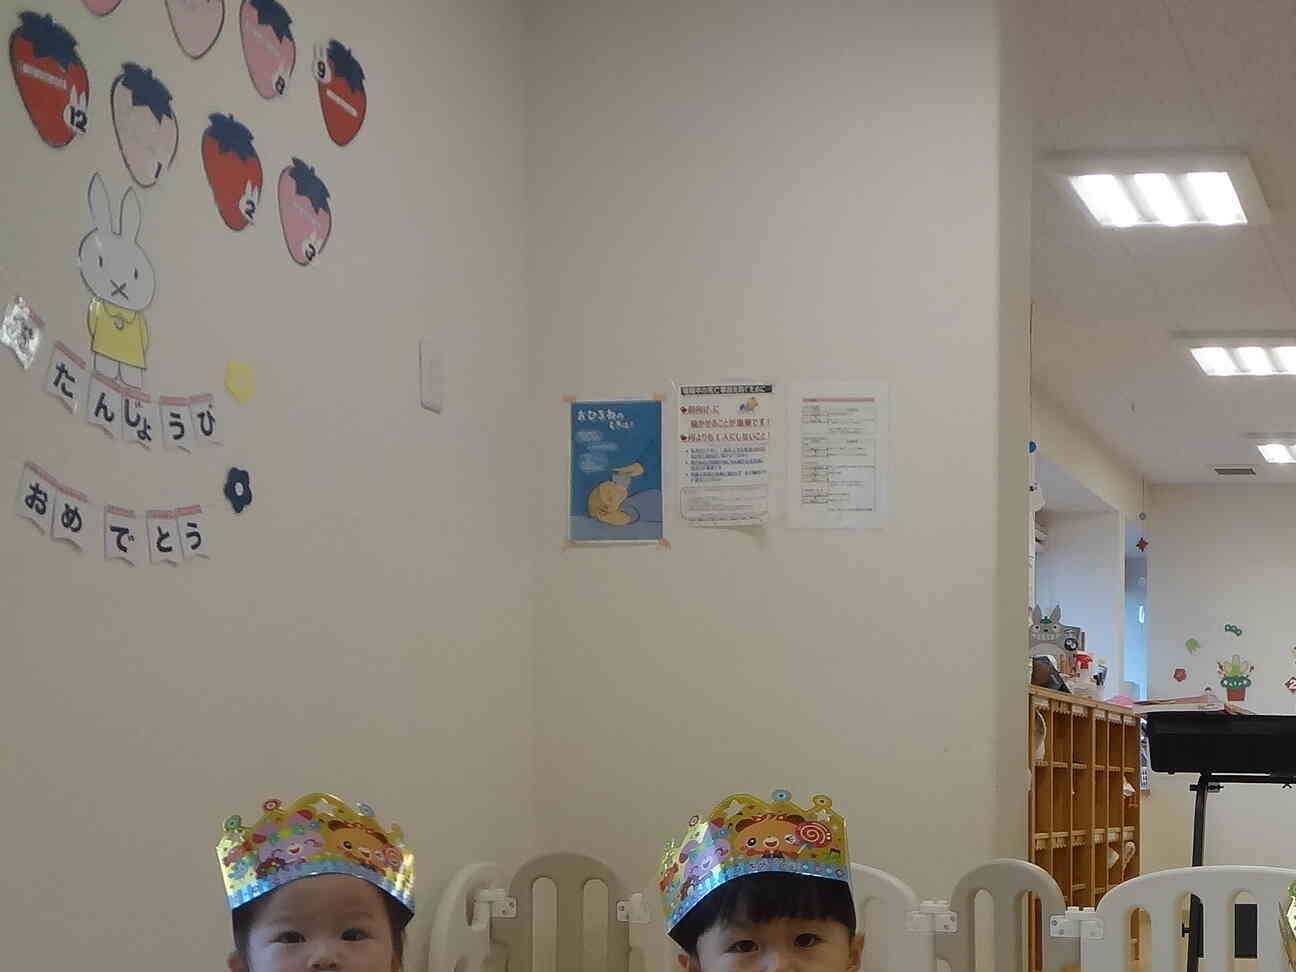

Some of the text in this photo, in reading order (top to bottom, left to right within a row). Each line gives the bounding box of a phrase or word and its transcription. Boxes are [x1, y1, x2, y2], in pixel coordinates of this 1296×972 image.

[69, 105, 88, 134] 12
[245, 199, 257, 218] 2
[25, 482, 203, 553] おめでとう
